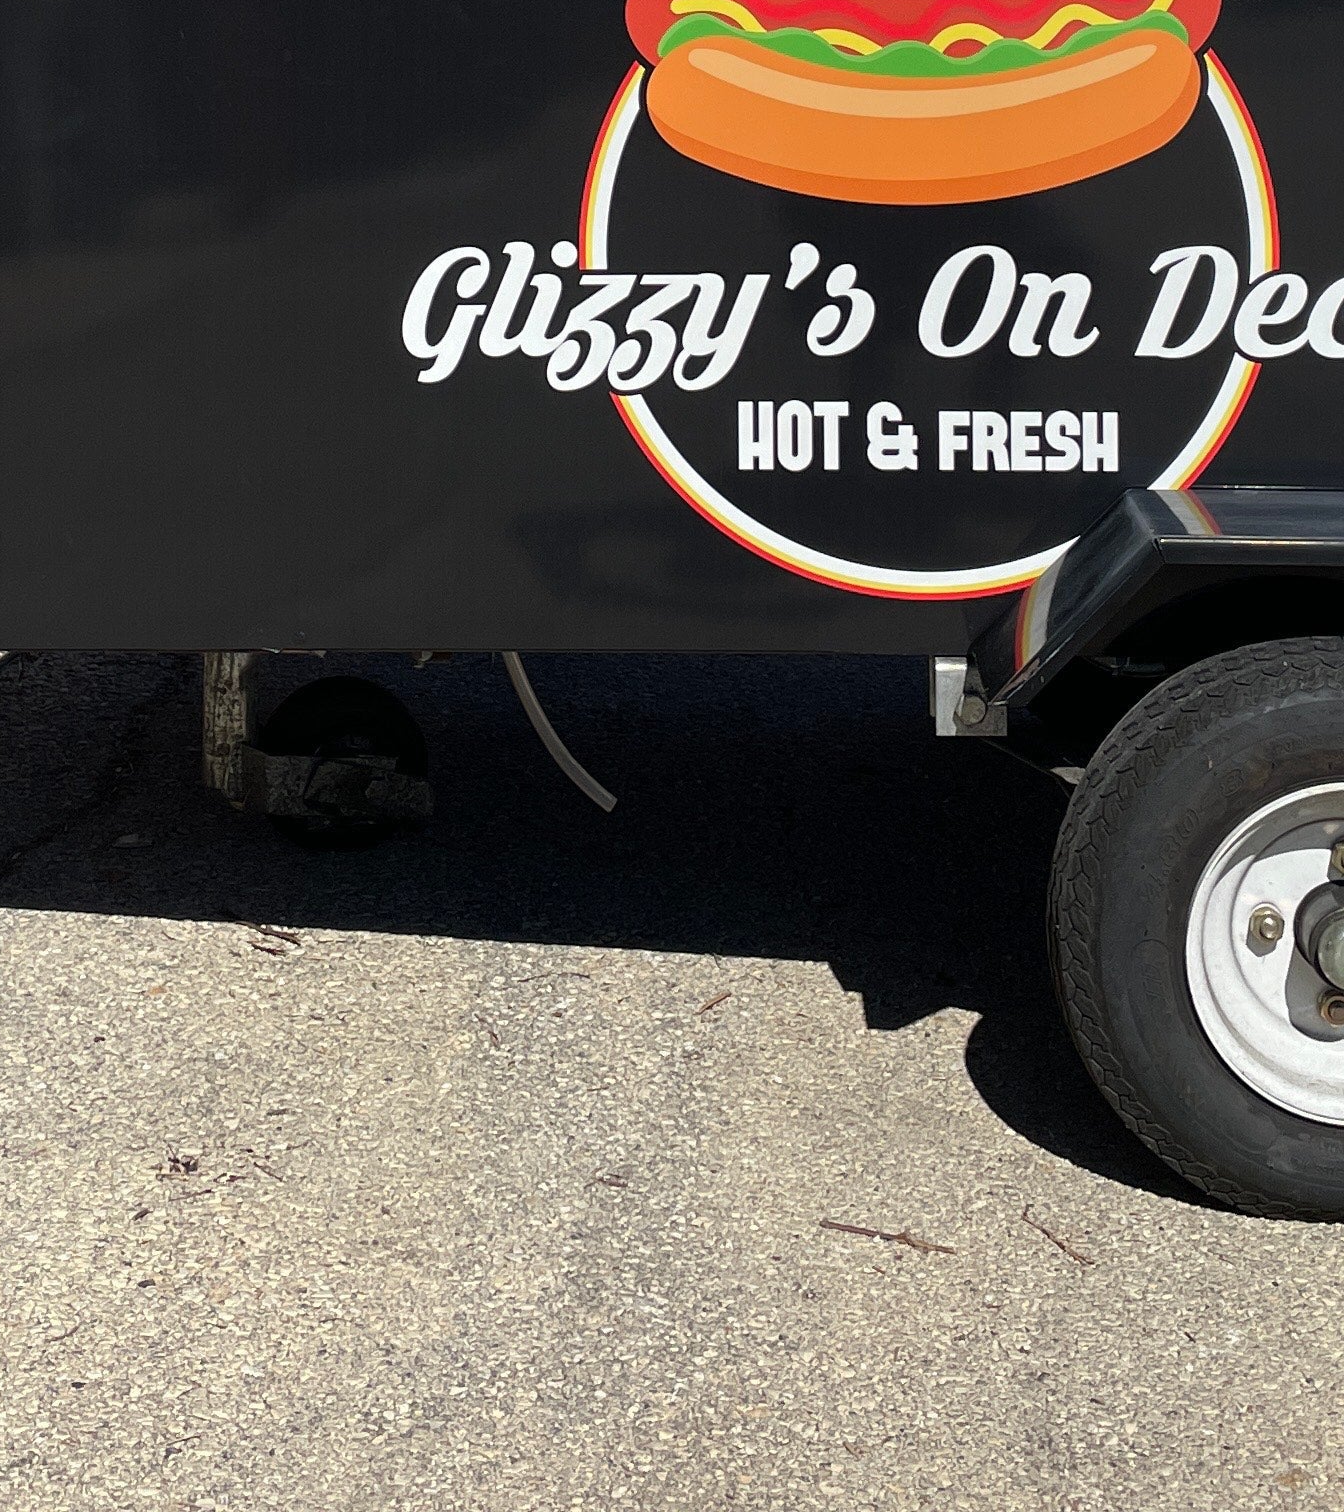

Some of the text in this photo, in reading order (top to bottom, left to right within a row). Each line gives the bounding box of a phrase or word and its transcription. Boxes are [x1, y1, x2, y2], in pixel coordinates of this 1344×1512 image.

[401, 241, 875, 393] Glizzy's
[918, 244, 1100, 359] On
[737, 399, 1120, 472] HOT & FRESH
